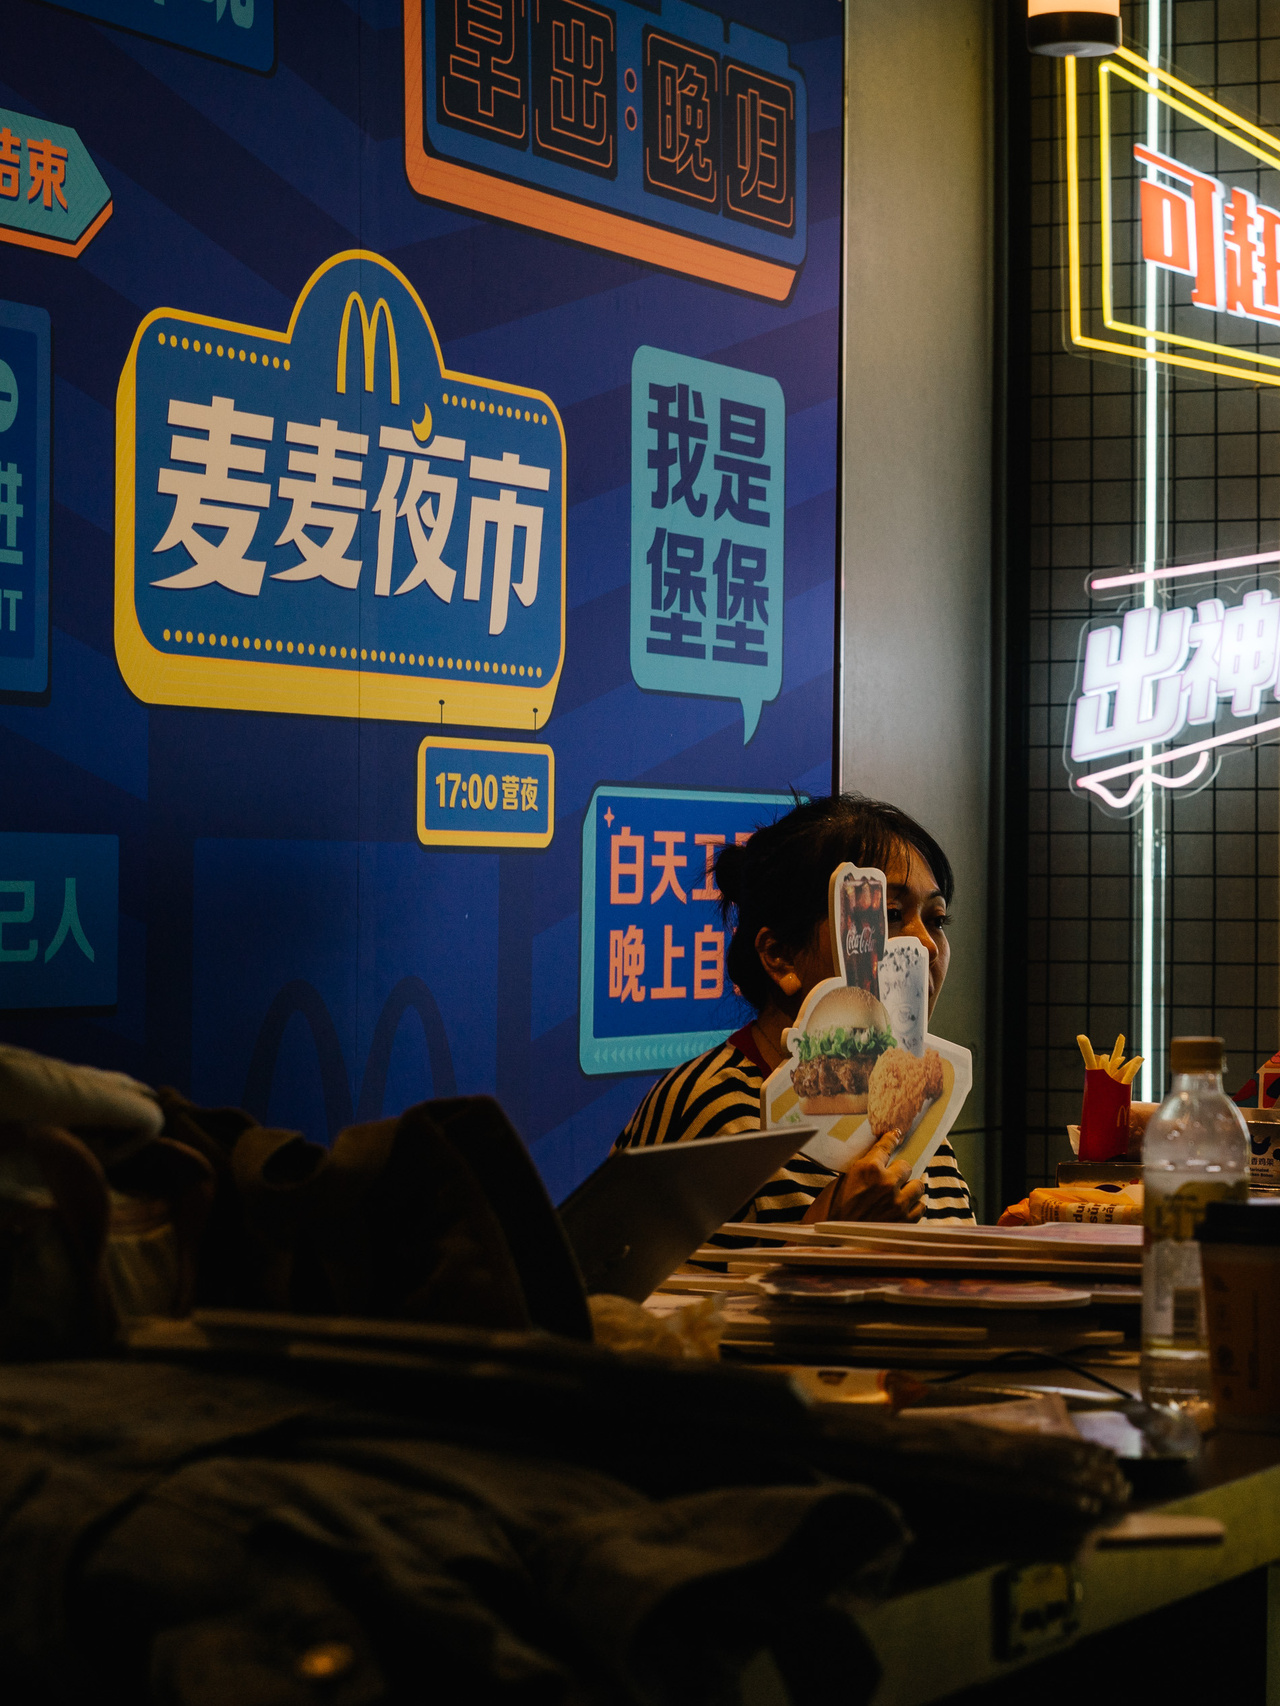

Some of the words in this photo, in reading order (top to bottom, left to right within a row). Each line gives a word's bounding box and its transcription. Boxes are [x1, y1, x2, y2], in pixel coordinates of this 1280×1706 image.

[647, 383, 771, 529] 我是
[149, 395, 551, 636] 麦麦夜市
[435, 772, 498, 810] 17:00
[501, 775, 539, 812] 营夜
[610, 826, 756, 905] 白天工
[609, 924, 742, 1004] 晚上自
